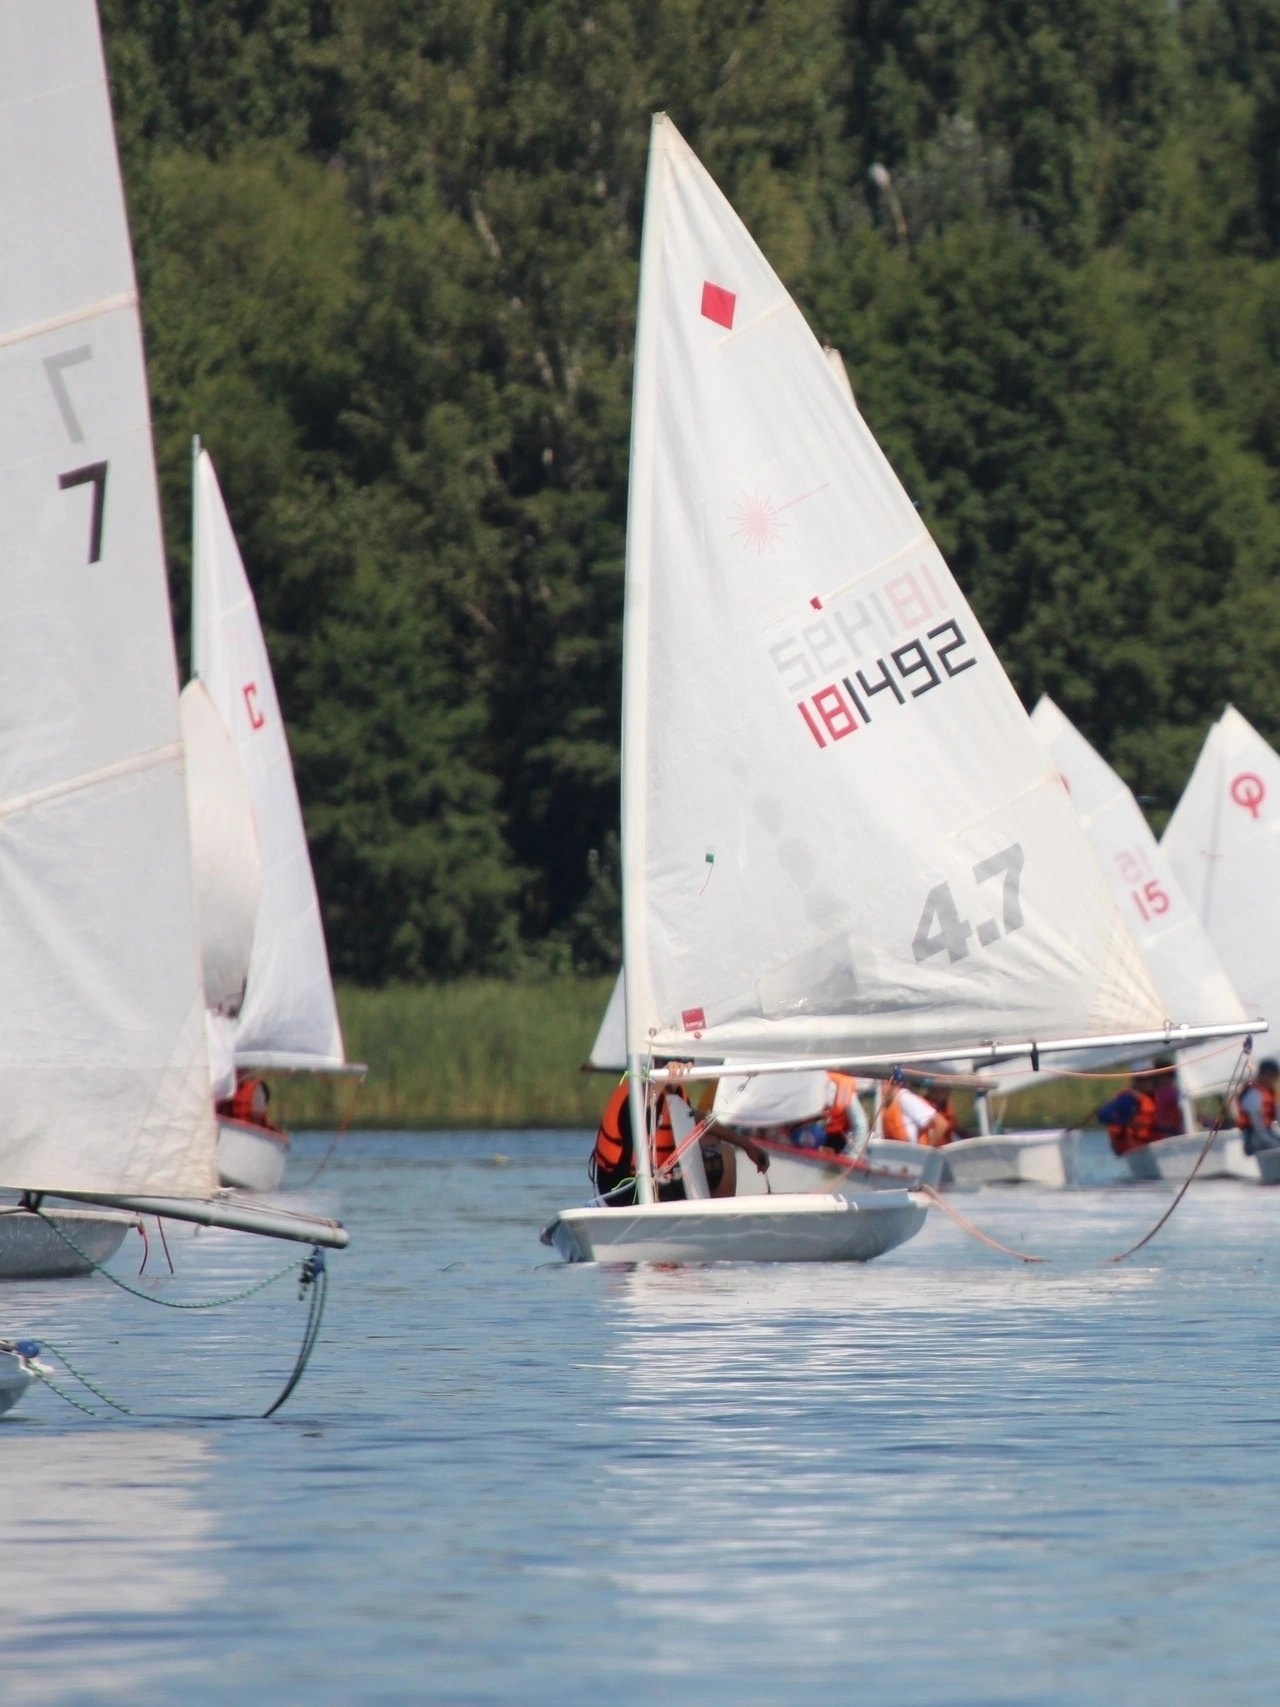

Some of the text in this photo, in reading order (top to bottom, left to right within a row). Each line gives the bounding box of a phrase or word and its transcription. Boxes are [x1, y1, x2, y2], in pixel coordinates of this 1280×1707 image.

[58, 460, 109, 564] 7
[797, 618, 977, 749] 181492
[911, 843, 1025, 964] 4.7
[1132, 878, 1171, 923] 15
